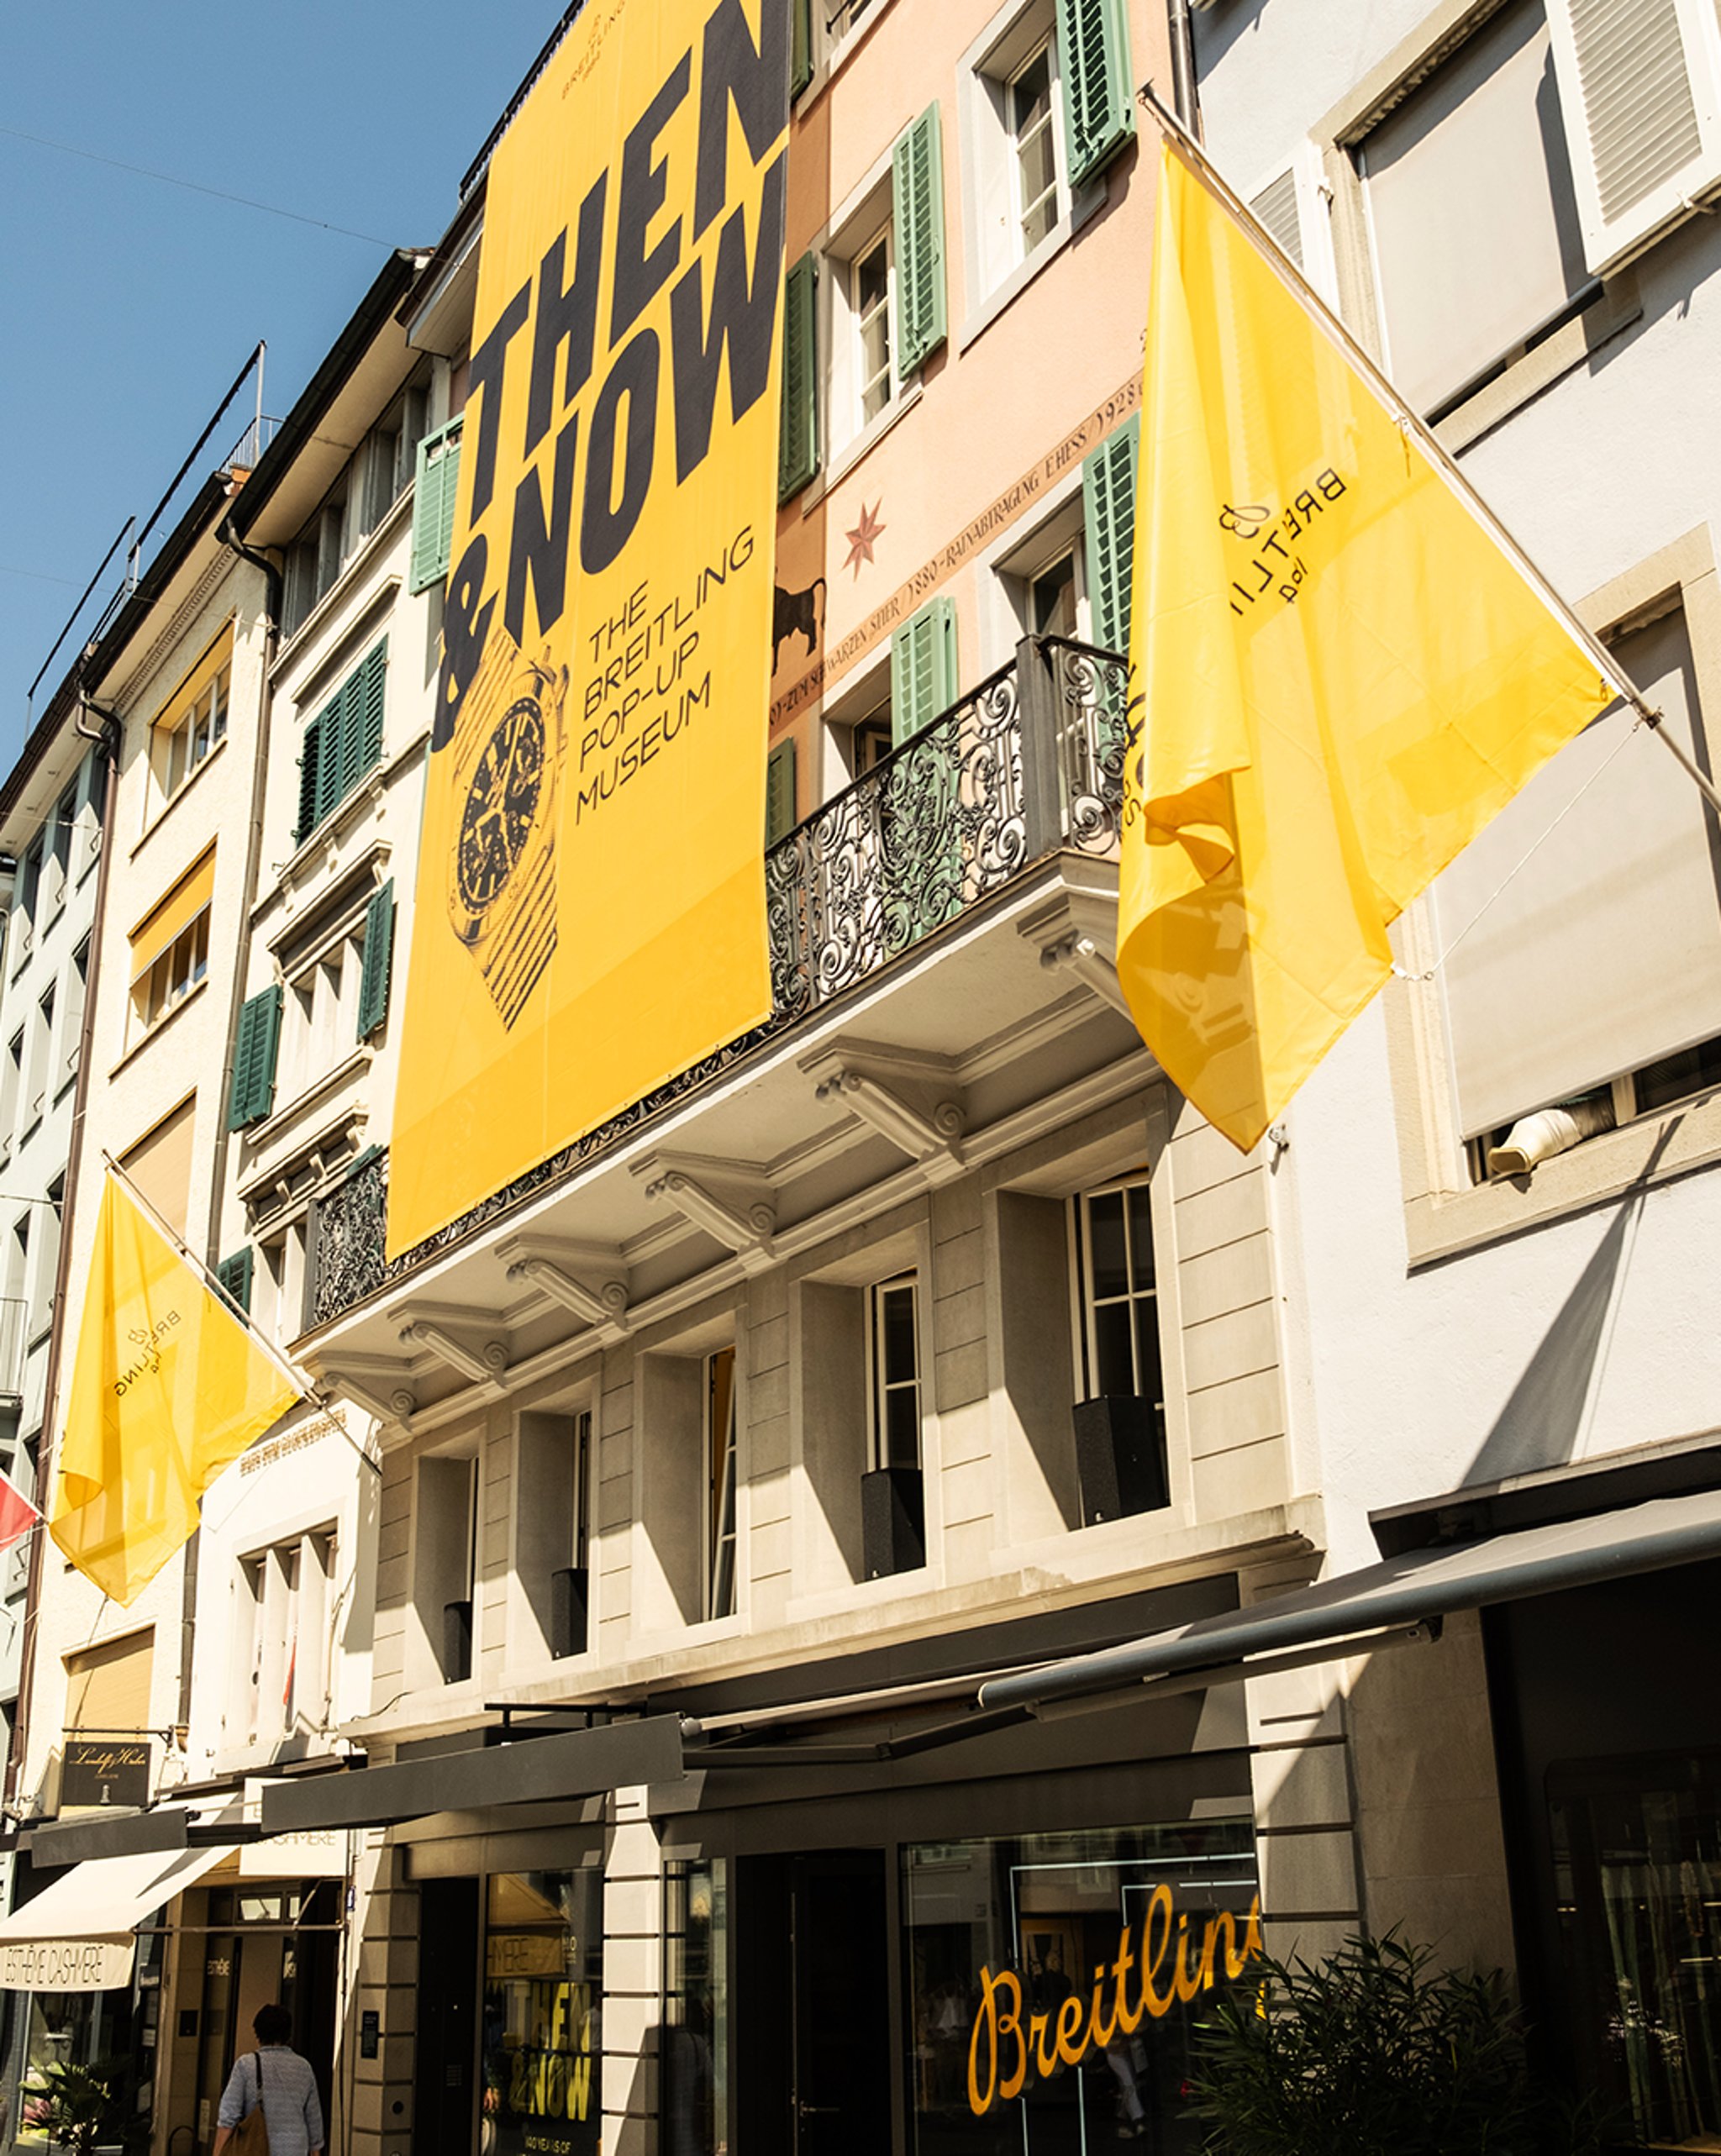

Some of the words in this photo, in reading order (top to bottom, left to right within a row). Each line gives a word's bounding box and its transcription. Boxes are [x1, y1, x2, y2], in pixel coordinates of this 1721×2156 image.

[468, 0, 790, 528] THEN
[583, 524, 755, 721] BREITLING
[590, 581, 649, 663] THE
[576, 671, 711, 826] MUSEUM
[580, 631, 700, 772] POP-UP
